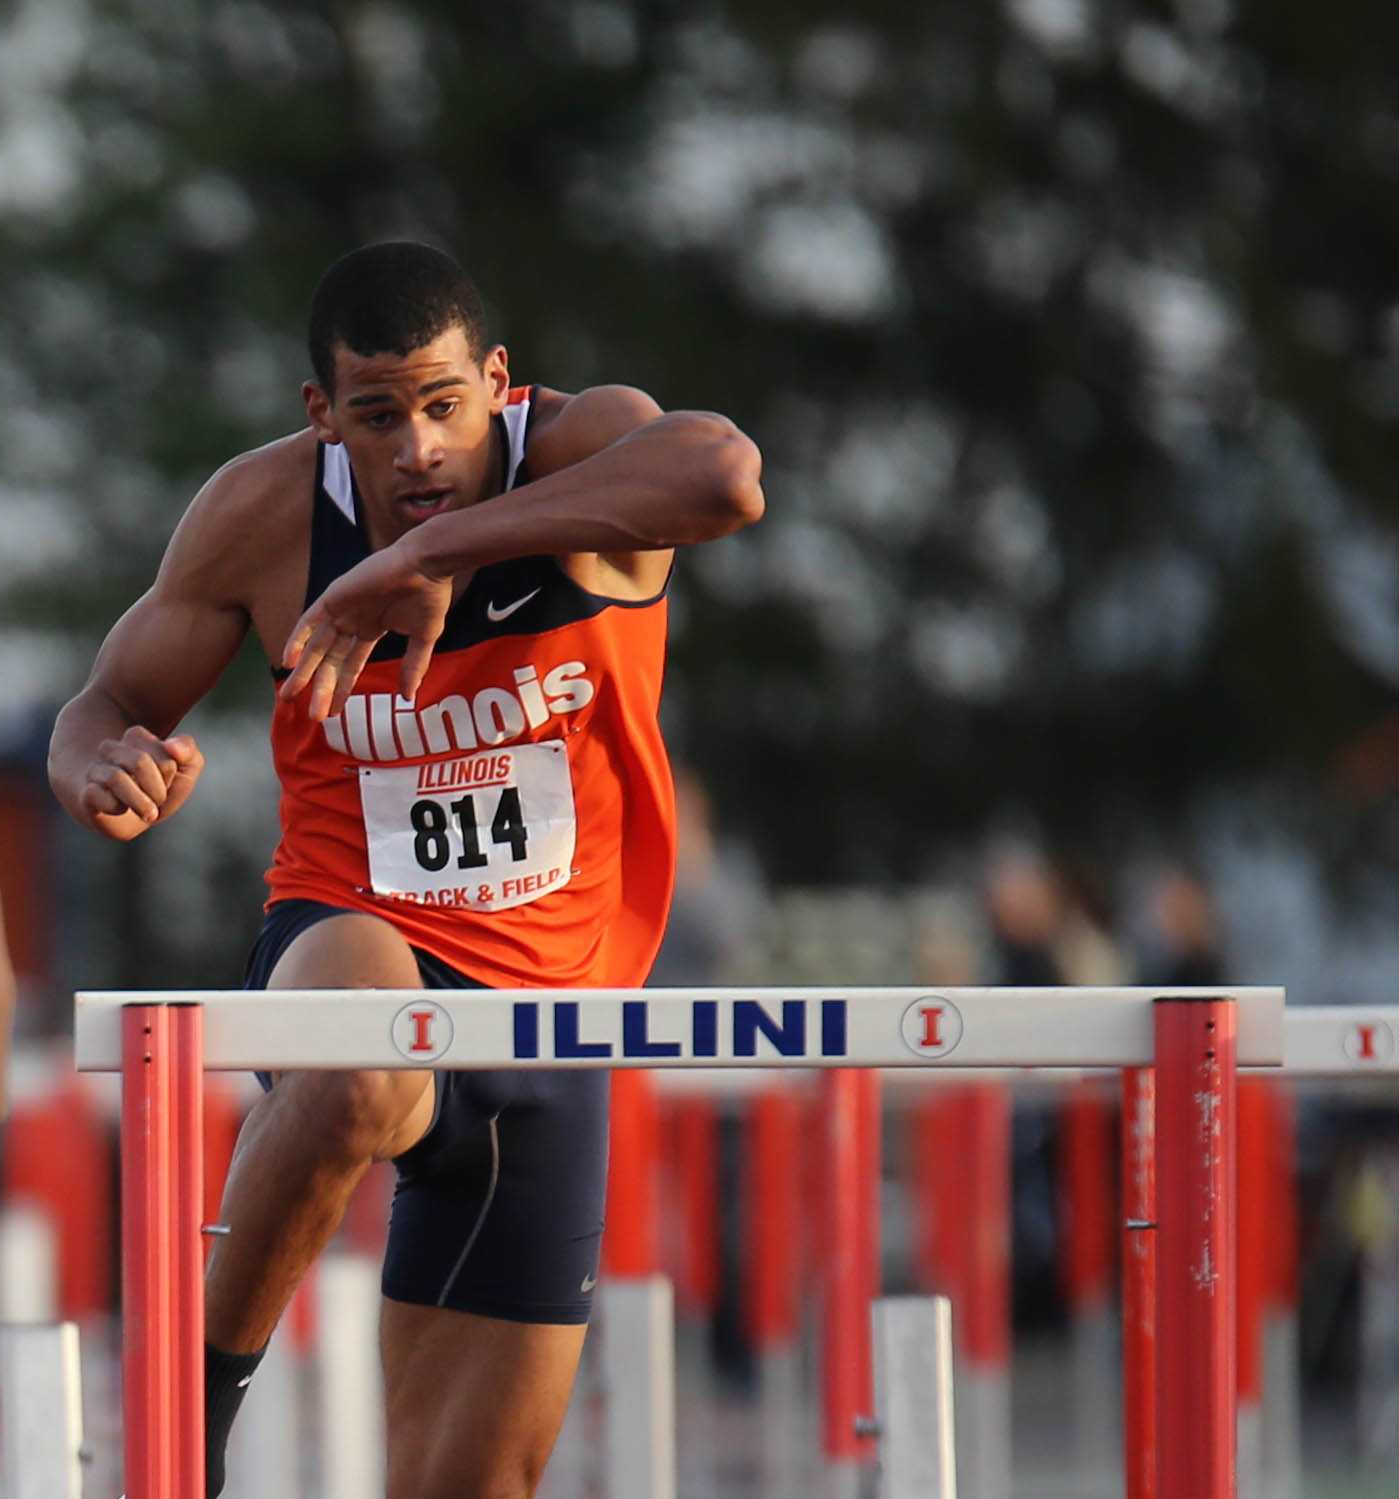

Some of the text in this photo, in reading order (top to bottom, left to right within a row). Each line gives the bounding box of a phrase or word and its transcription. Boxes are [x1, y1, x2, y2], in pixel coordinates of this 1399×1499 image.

[321, 661, 594, 762] Illinois
[417, 755, 512, 790] ILLINOIS
[410, 788, 528, 872] 814
[477, 883, 495, 903] &
[502, 867, 561, 898] FIELD
[513, 1001, 847, 1058] ILLINI
